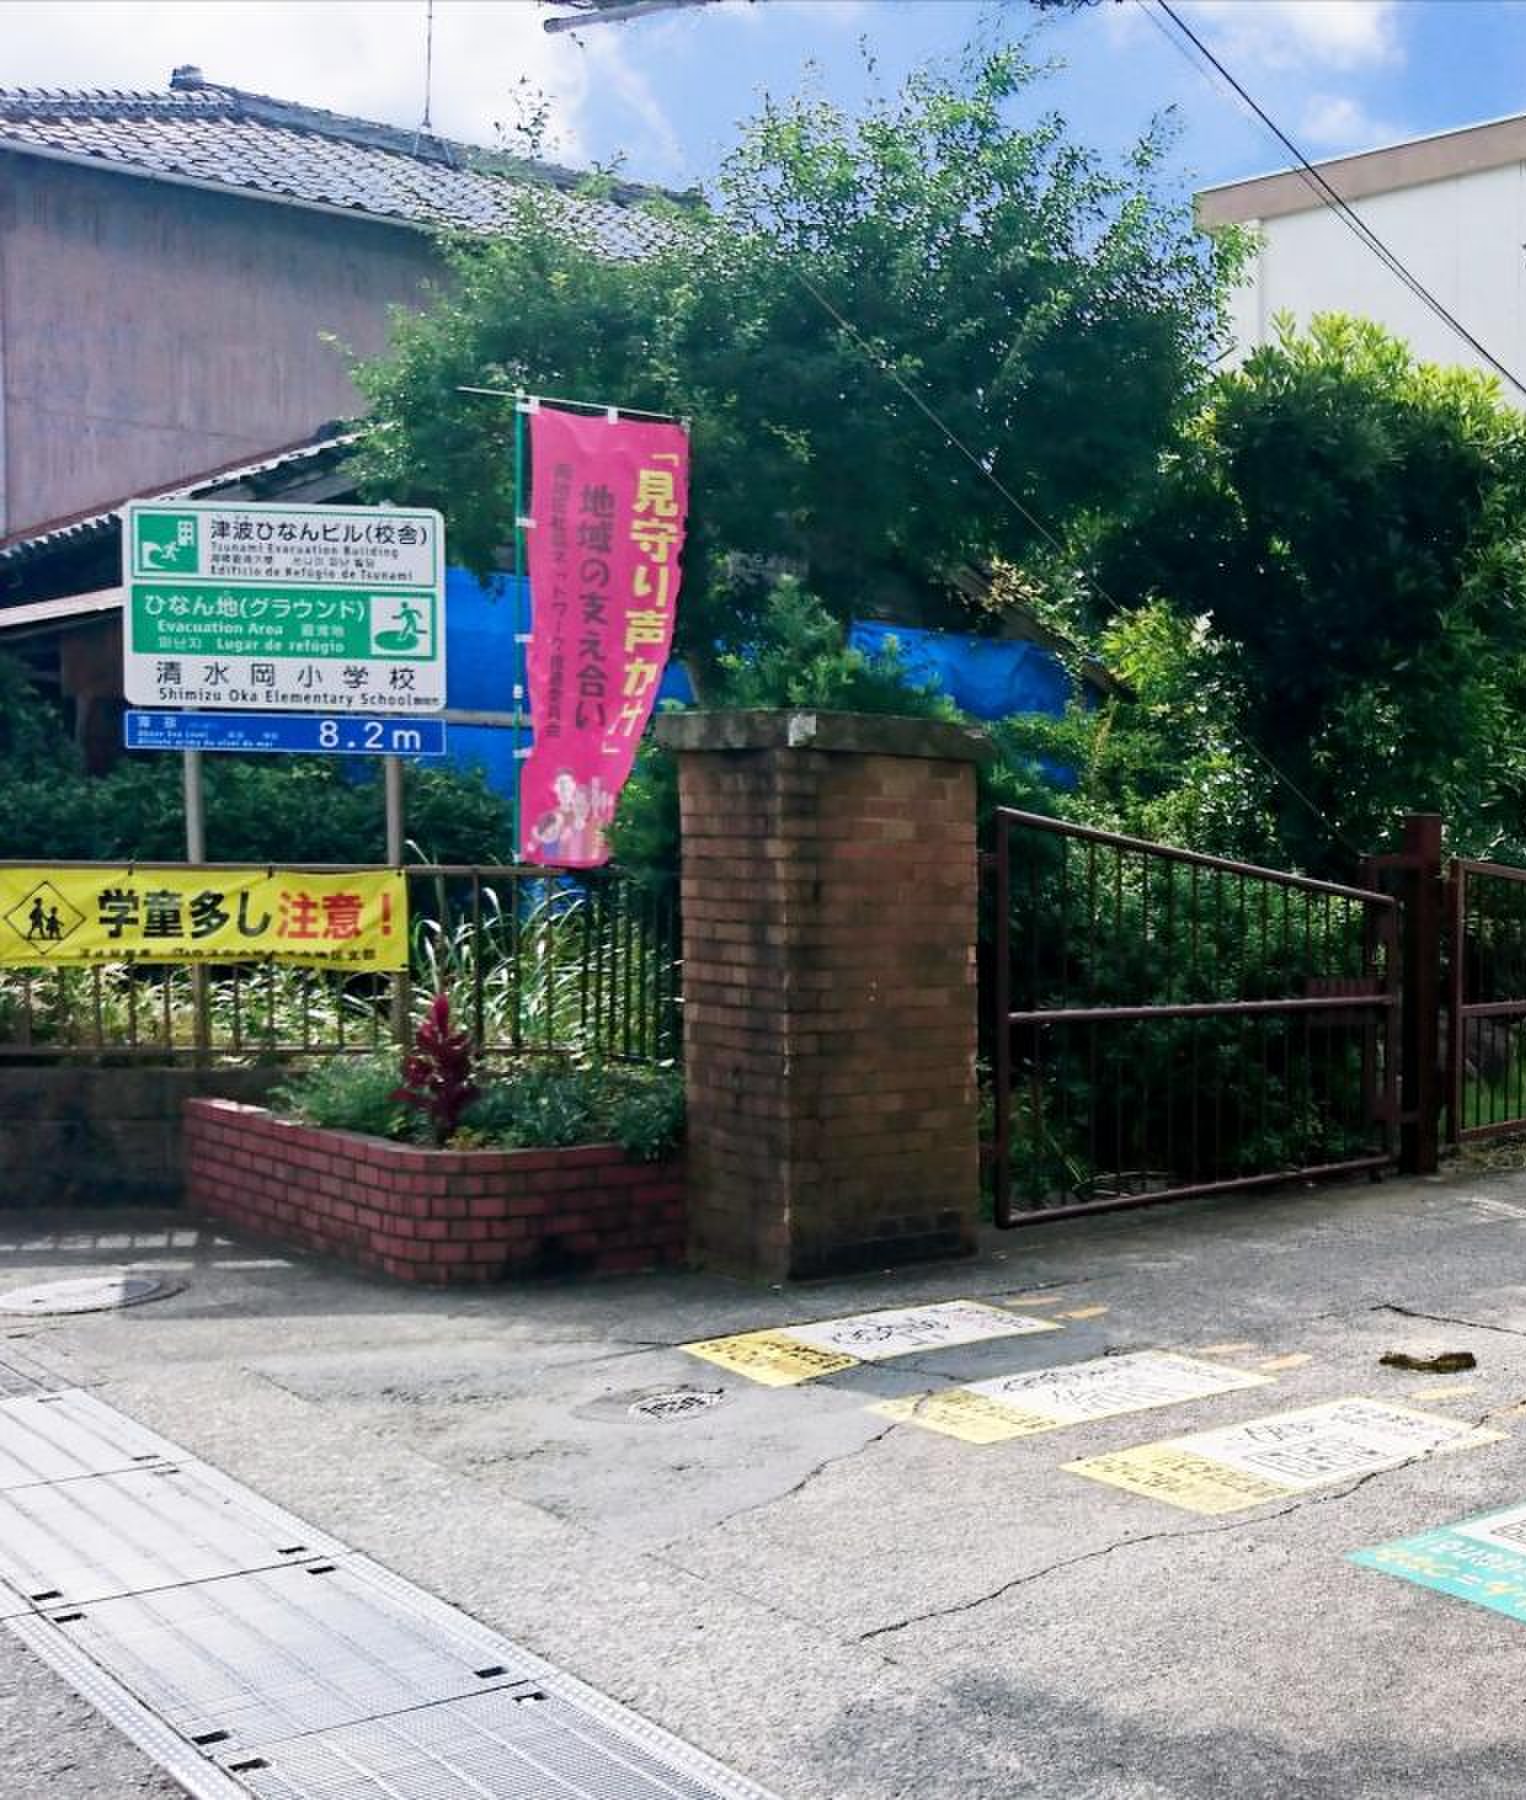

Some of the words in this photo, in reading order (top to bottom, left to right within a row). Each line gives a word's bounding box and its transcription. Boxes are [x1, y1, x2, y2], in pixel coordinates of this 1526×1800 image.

[210, 541, 263, 553] Tsunami
[267, 542, 339, 556] Evacuation
[343, 545, 400, 560] Building
[264, 566, 280, 577] de
[340, 569, 357, 579] de
[360, 569, 414, 582] Tsunami
[144, 594, 366, 623] ひなん地(グラウンド)
[575, 483, 617, 731] 地域の支え合い
[157, 619, 244, 635] Evacuation
[248, 622, 284, 636] Area
[216, 637, 259, 653] Lugar
[263, 638, 283, 651] de
[156, 660, 416, 691] 清水岡小学校
[159, 687, 222, 702] Shimizu
[228, 688, 258, 702] Oka
[265, 690, 353, 707] Elementary
[360, 692, 411, 707] School
